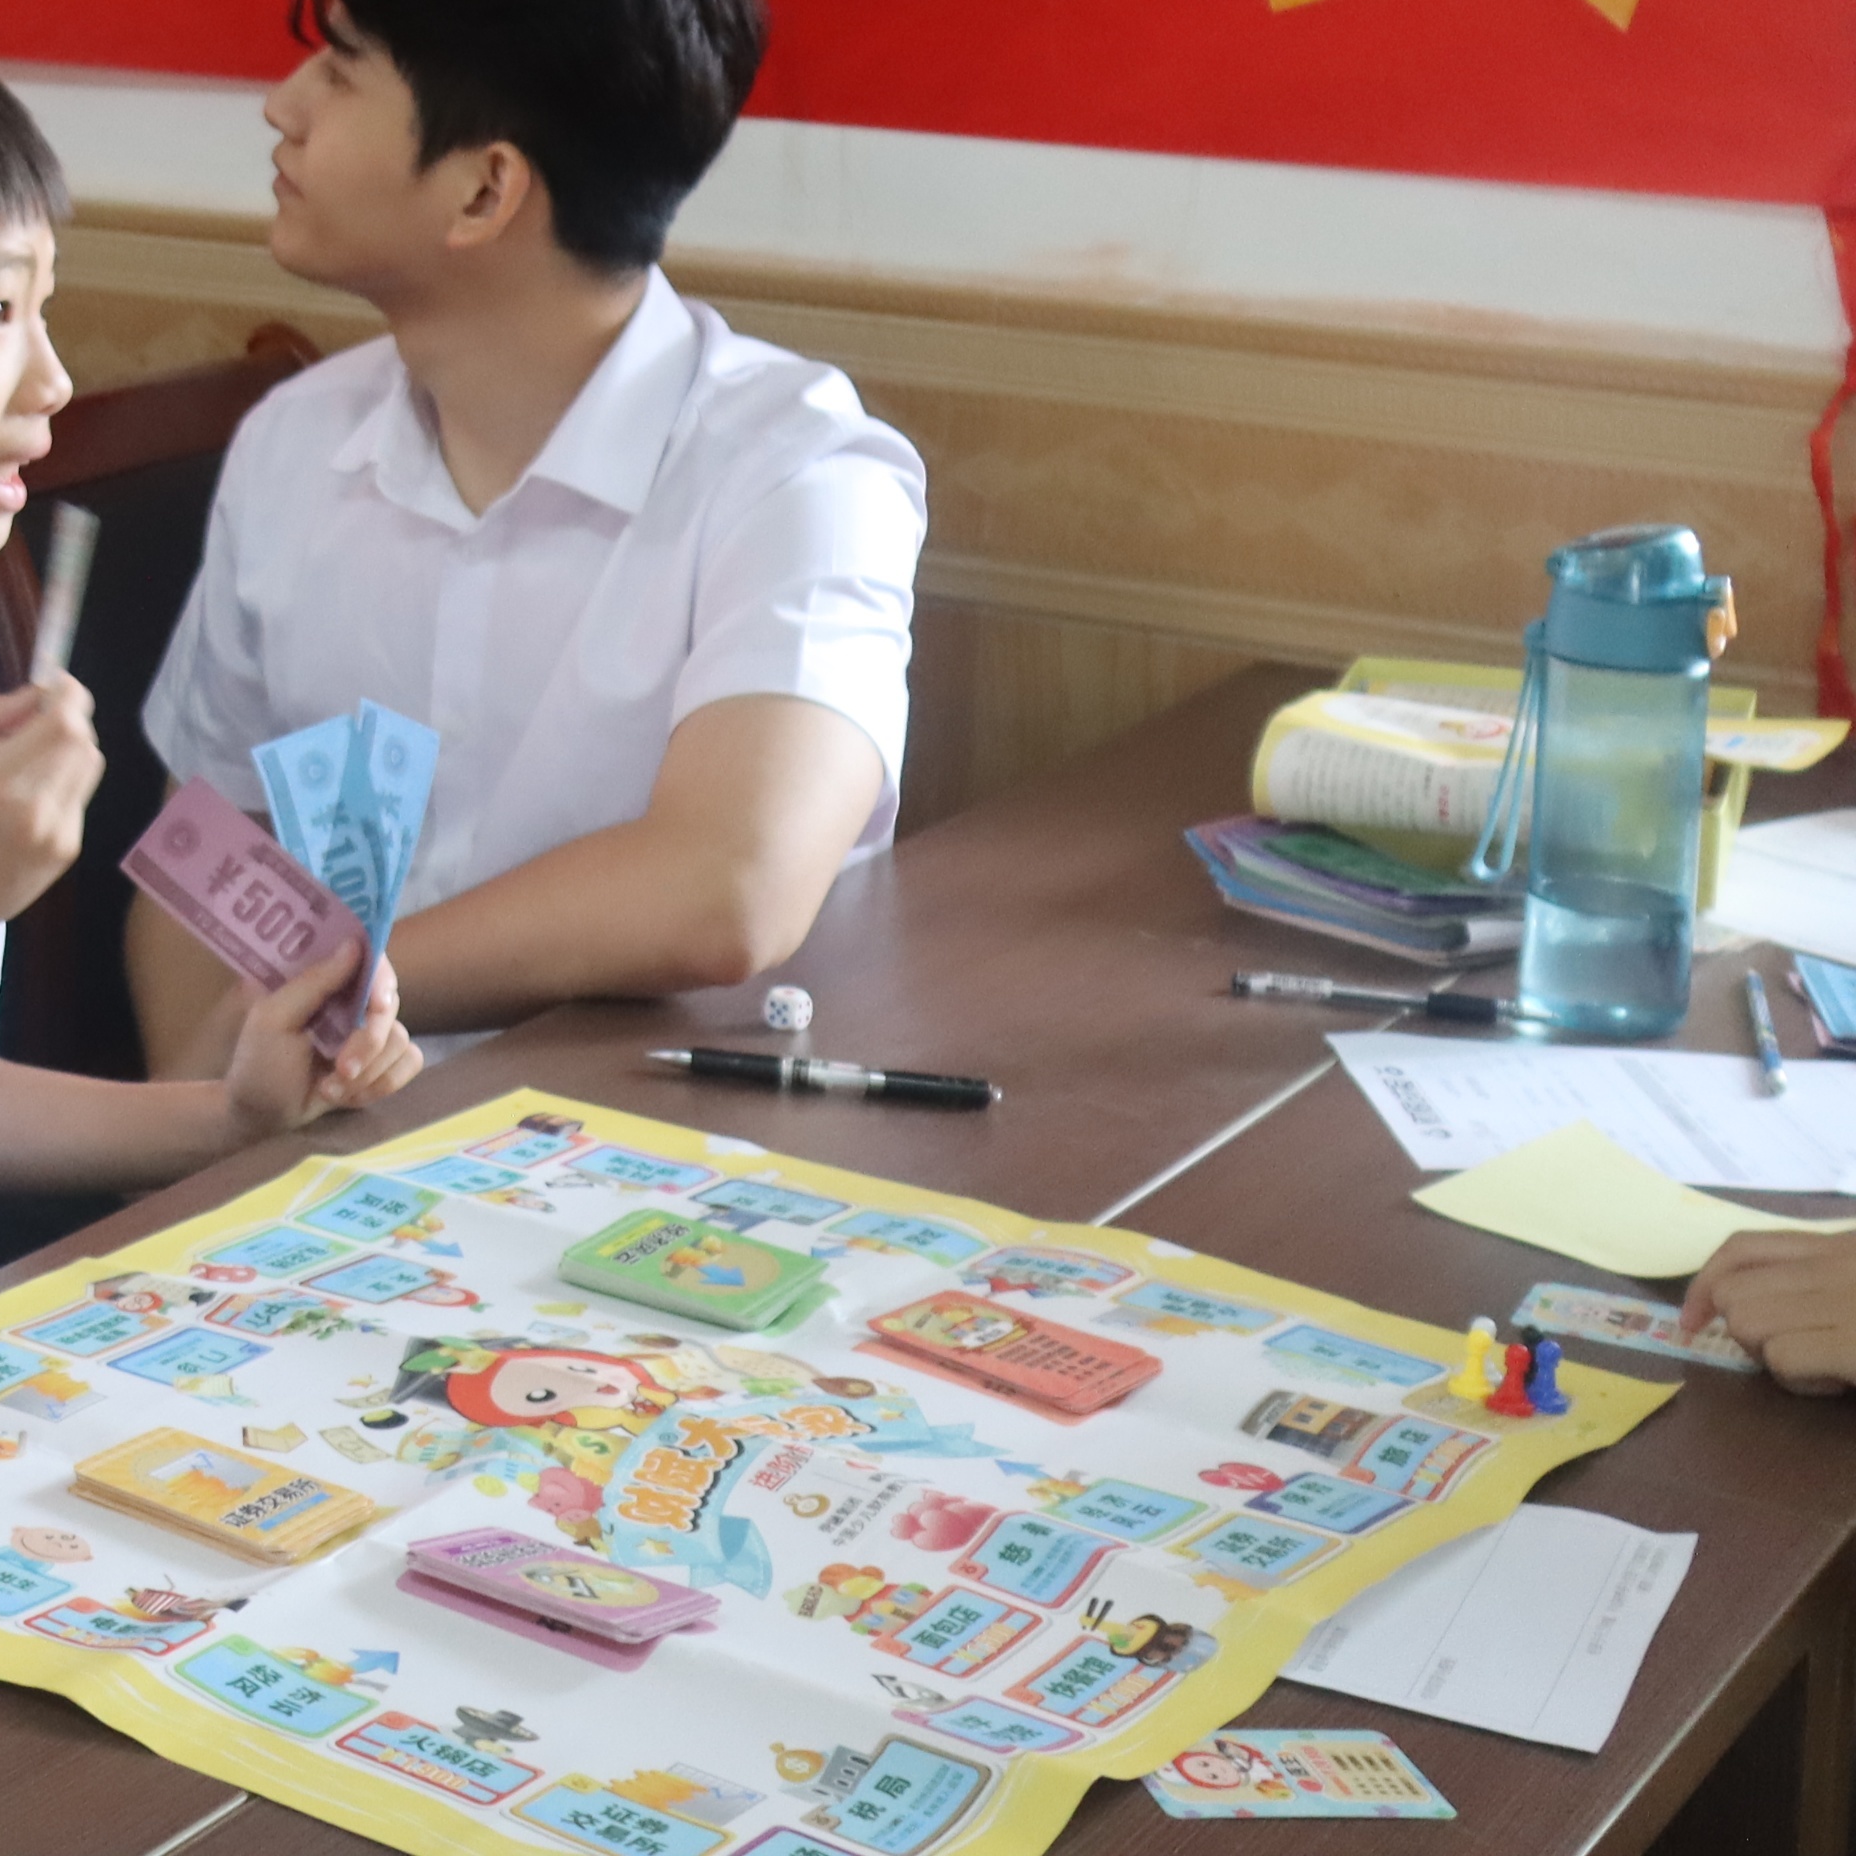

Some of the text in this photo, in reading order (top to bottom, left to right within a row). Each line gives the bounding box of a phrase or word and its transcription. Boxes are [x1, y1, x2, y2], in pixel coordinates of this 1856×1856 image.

[217, 1476, 324, 1530] 证券交易所
[910, 1602, 987, 1652] 面包店
[398, 1732, 504, 1779] 火锅店
[599, 1803, 670, 1836] 证券
[845, 1774, 913, 1822] 税局
[560, 1808, 669, 1856] 交易所
